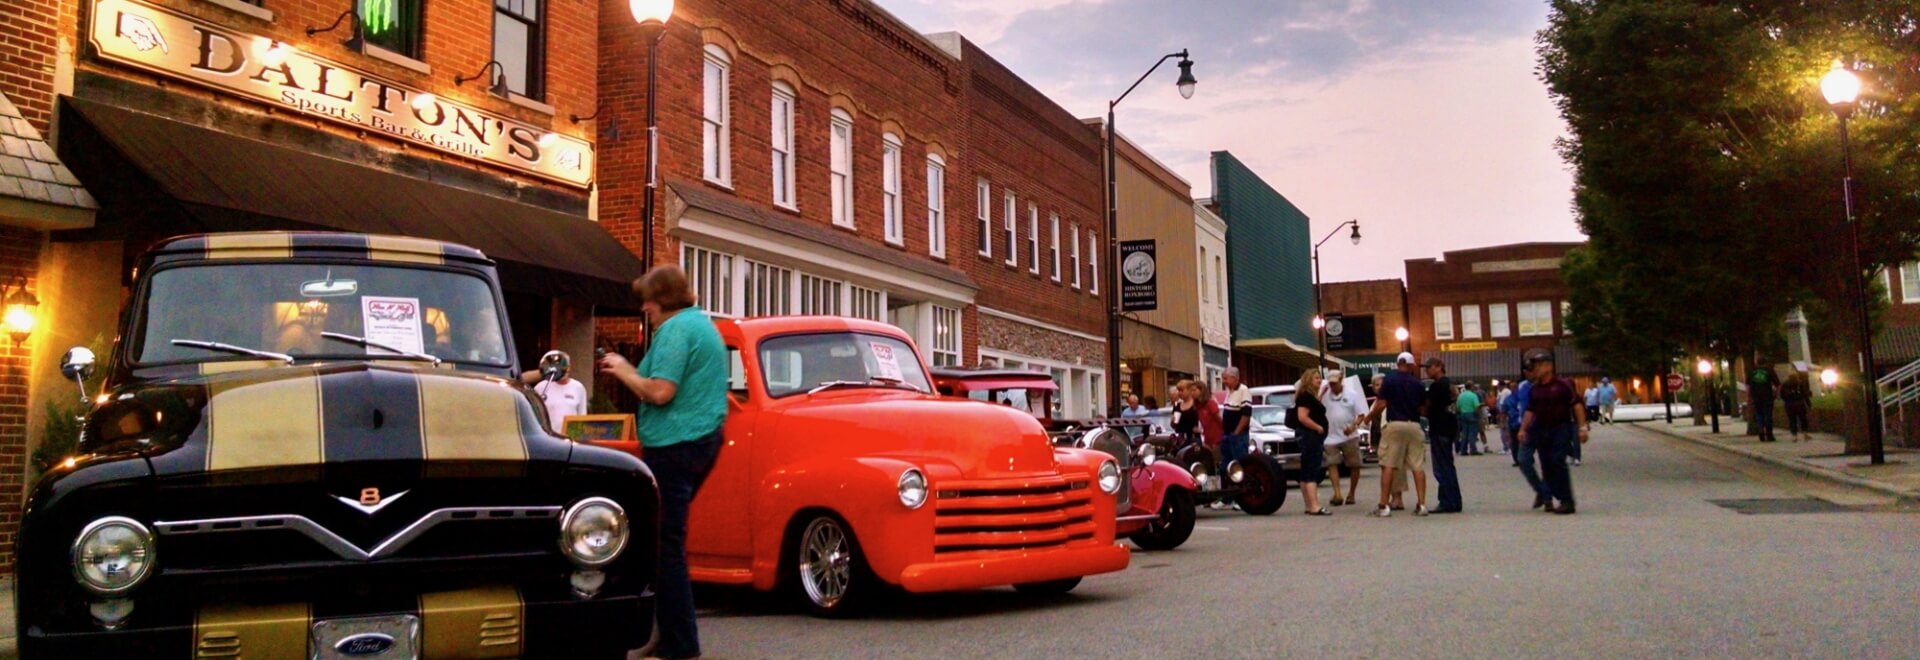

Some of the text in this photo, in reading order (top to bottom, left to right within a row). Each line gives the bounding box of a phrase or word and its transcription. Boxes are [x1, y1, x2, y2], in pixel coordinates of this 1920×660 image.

[190, 25, 540, 162] DALTON'S
[281, 90, 485, 156] Sports Bar & Grille
[1122, 244, 1154, 252] WELCOME
[349, 639, 381, 654] Ford
